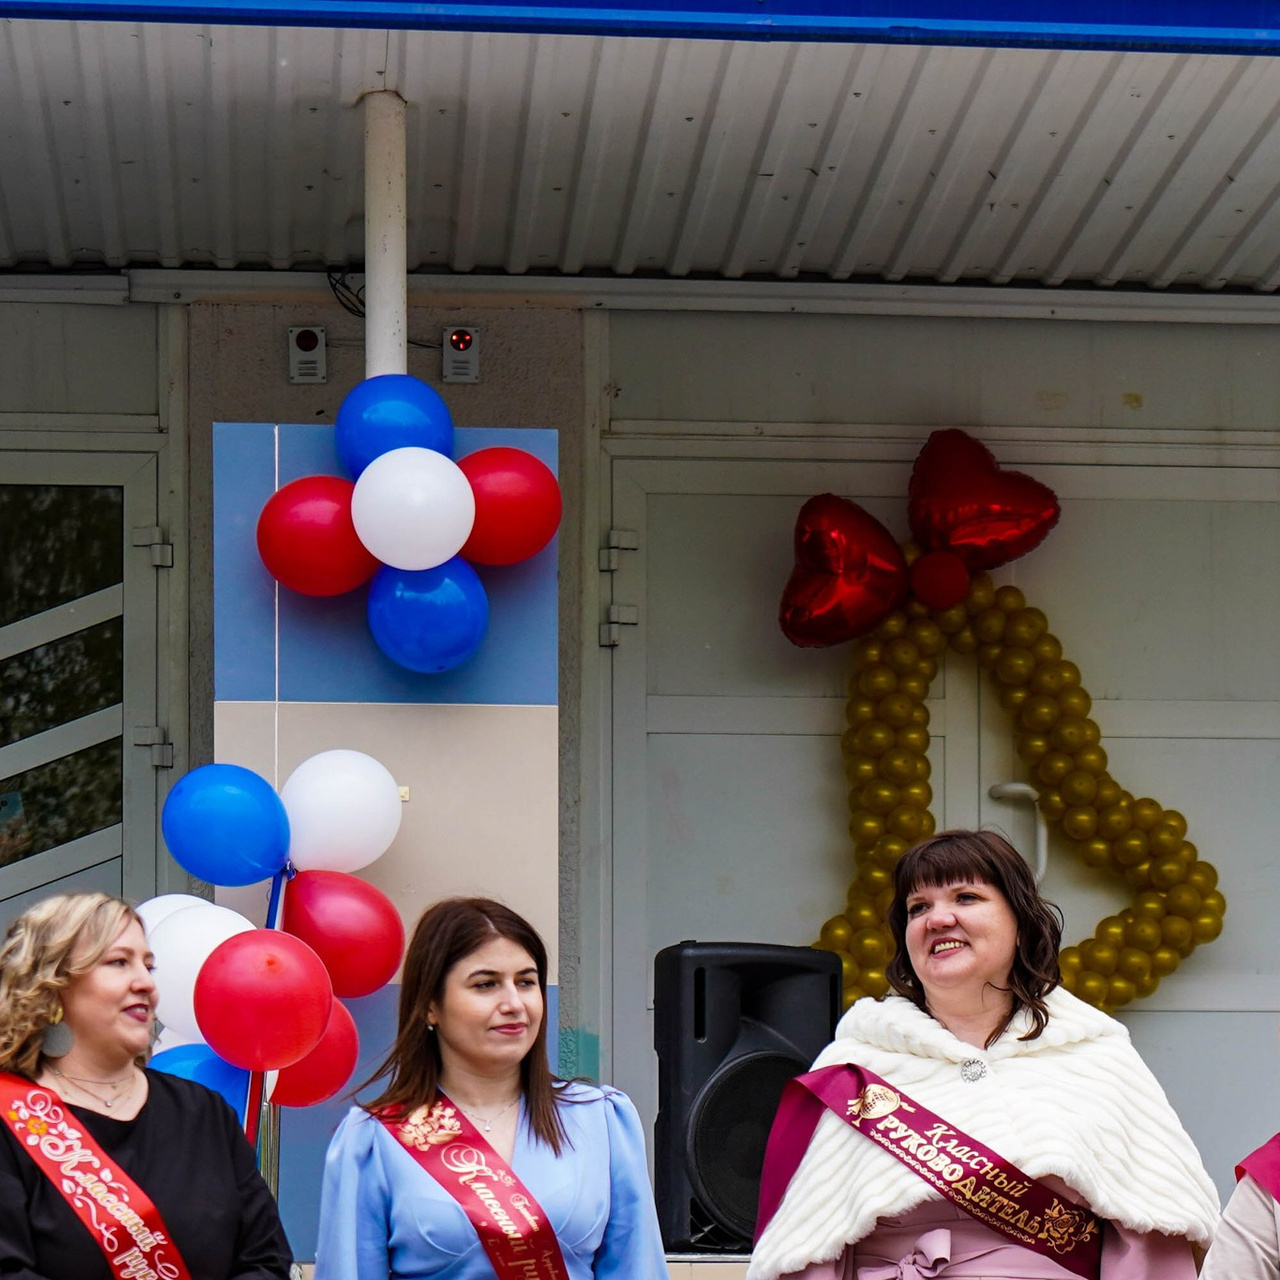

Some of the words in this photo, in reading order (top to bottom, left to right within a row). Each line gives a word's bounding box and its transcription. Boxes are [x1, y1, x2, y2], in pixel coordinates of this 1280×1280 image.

[39, 1135, 168, 1252] Классный
[441, 1142, 534, 1254] Классный
[876, 1115, 1040, 1236] РУКОВОДИТЕЛЬ
[924, 1122, 1032, 1198] Классный
